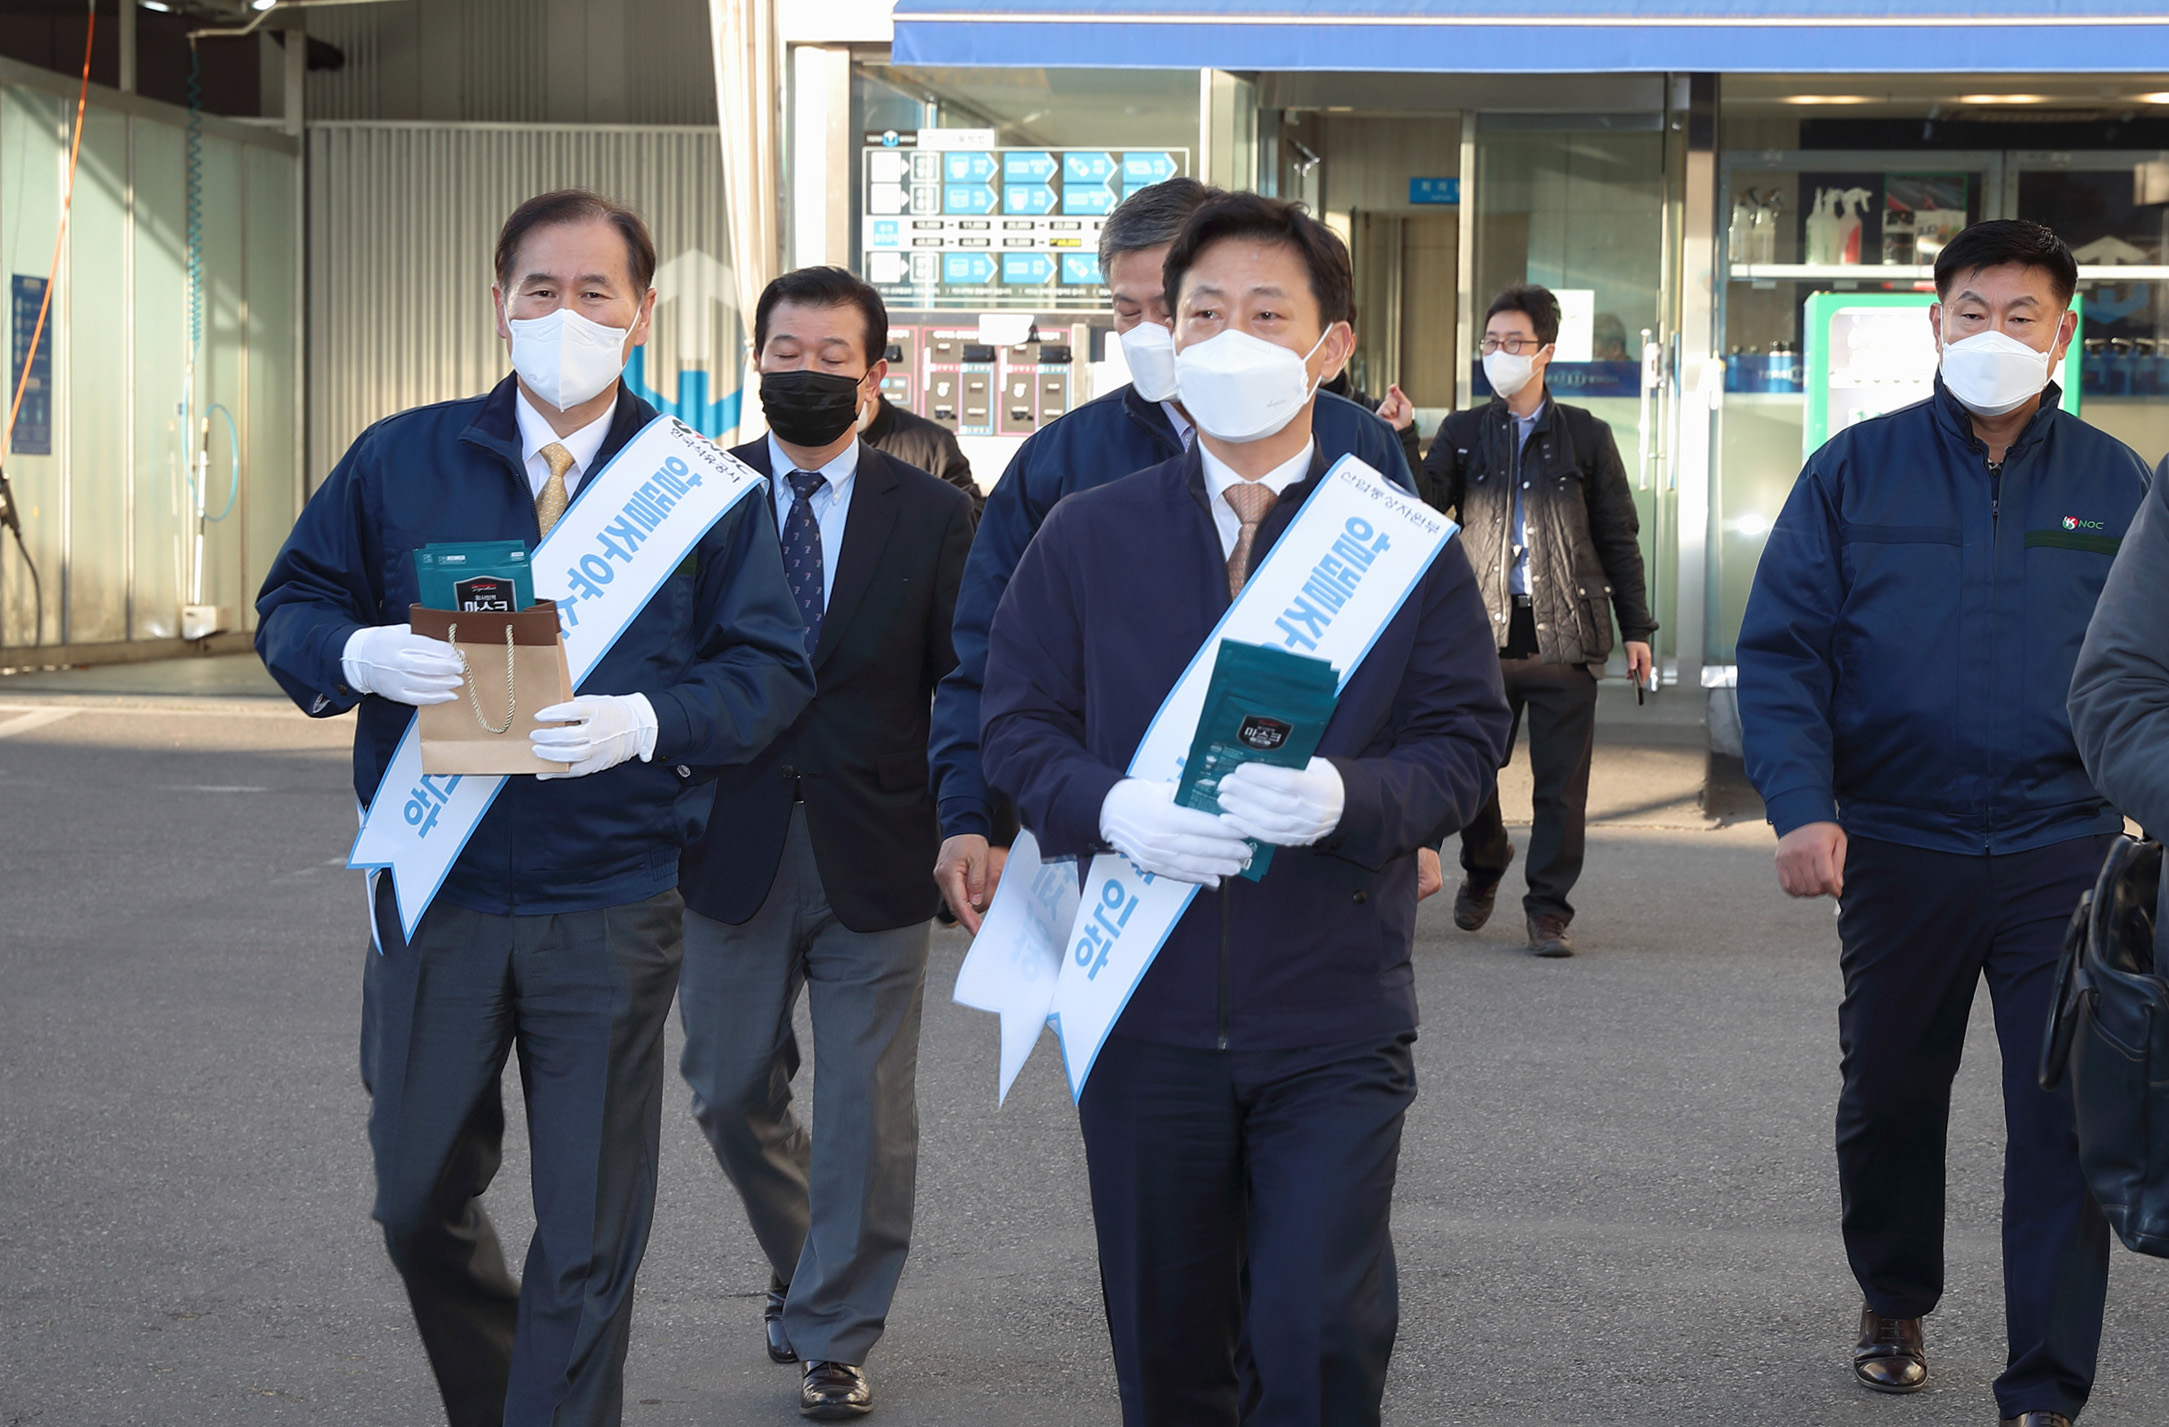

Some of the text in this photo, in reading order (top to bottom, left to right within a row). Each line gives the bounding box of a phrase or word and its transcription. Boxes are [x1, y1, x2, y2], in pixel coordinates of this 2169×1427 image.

[671, 428, 740, 483] 한국석유공사
[1341, 471, 1440, 533] 산업통상자원부
[1259, 515, 1390, 652] 알뜰주
[1243, 726, 1282, 743] 마스크
[1075, 877, 1141, 981] 인하
